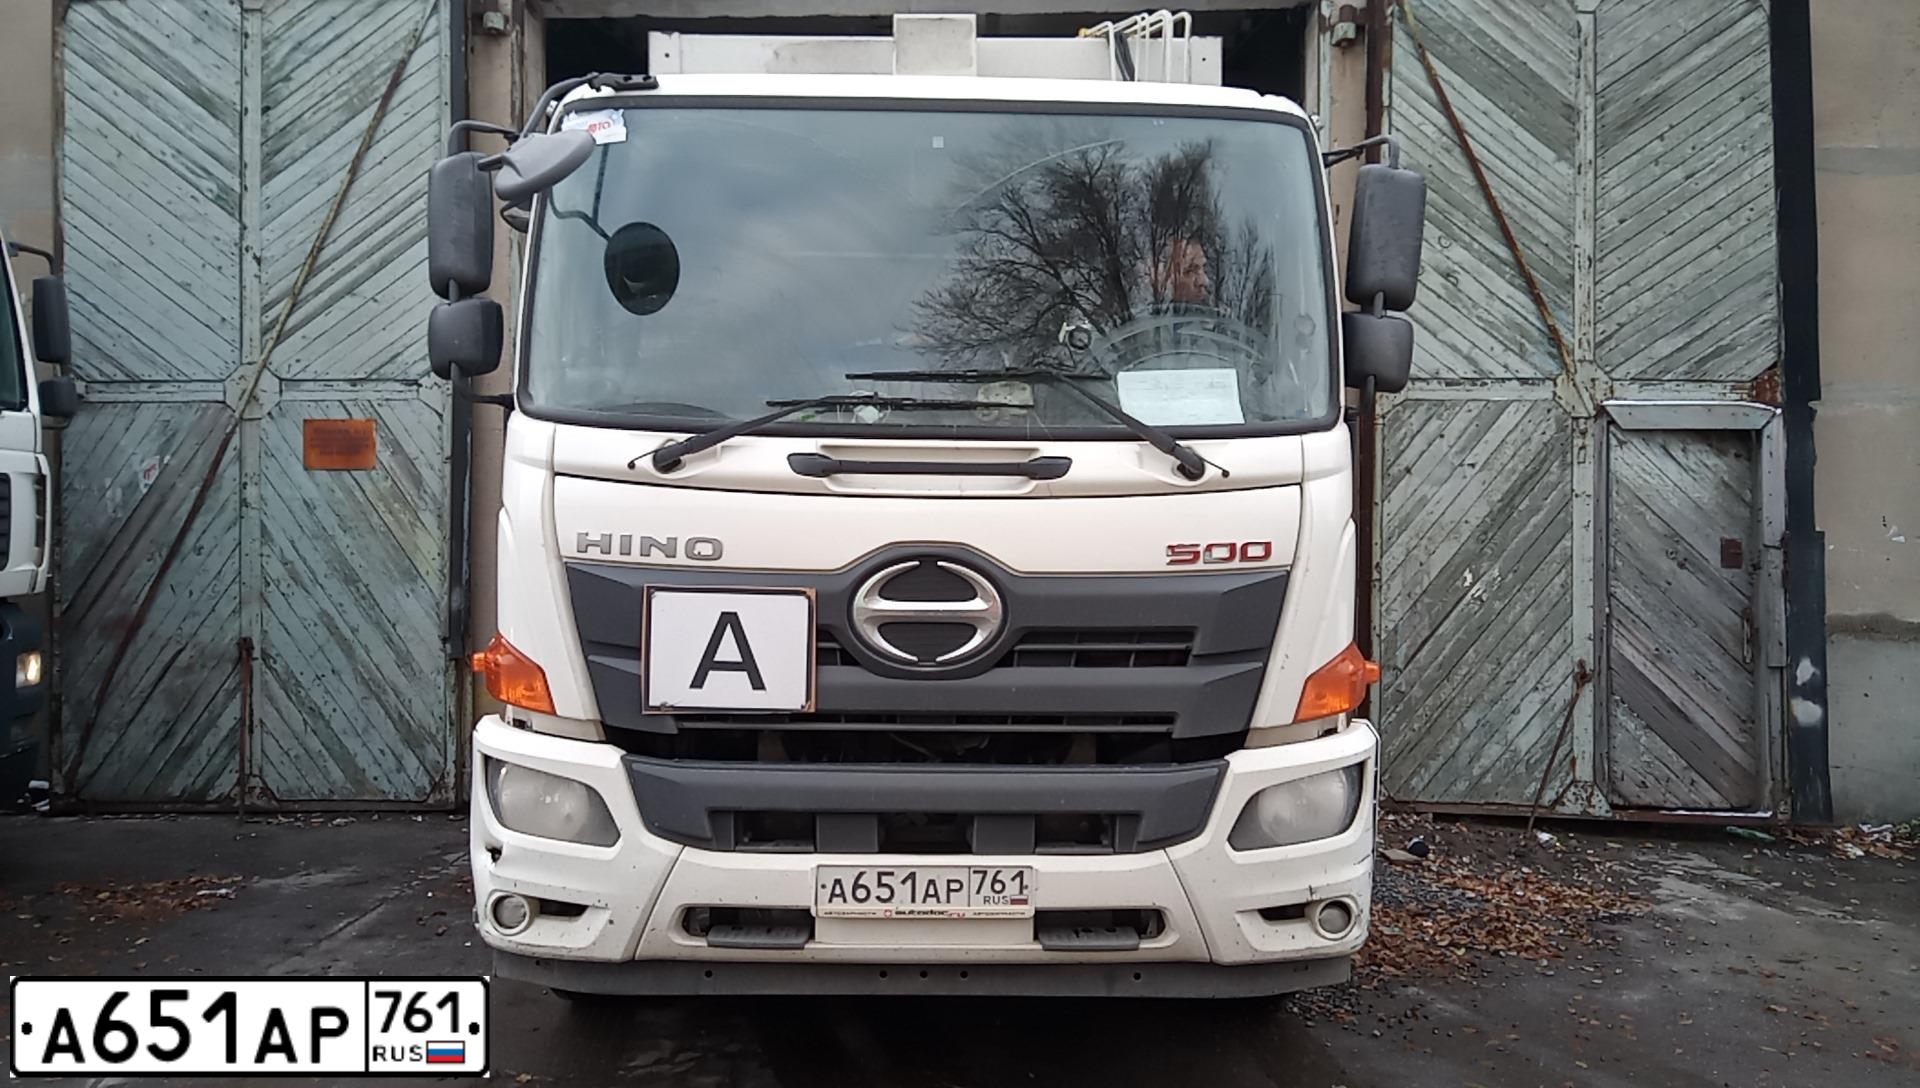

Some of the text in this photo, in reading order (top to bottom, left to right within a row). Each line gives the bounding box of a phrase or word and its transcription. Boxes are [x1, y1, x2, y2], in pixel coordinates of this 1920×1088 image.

[577, 531, 723, 561] HINO
[1166, 541, 1272, 565] 500
[689, 611, 767, 690] A
[828, 870, 1028, 904] А651АР 761
[983, 895, 1009, 905] RUS
